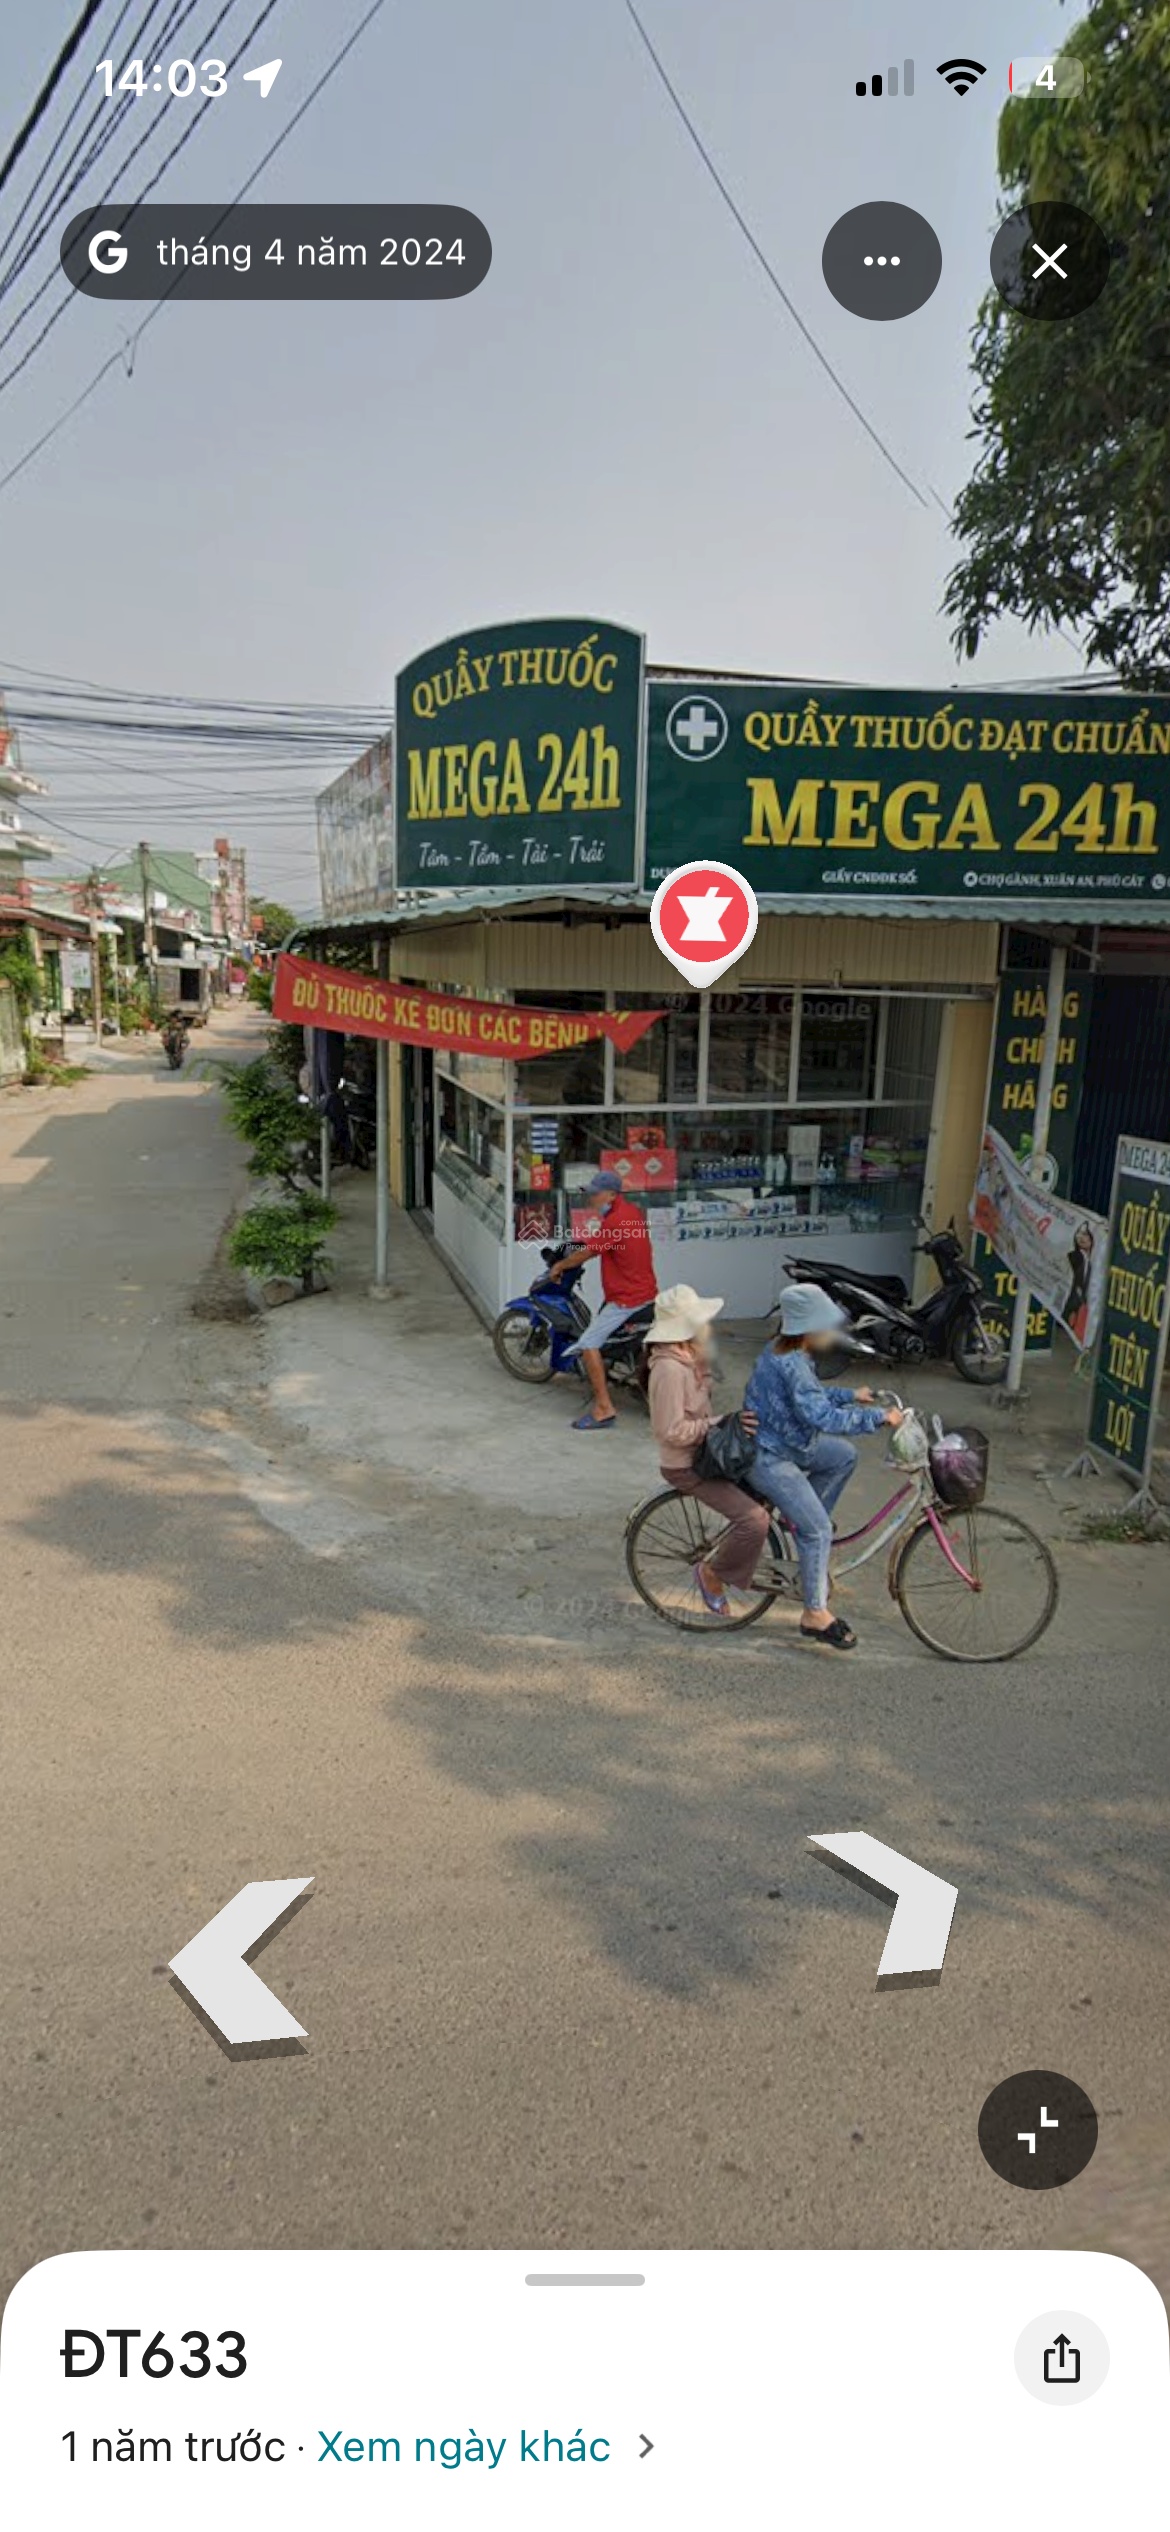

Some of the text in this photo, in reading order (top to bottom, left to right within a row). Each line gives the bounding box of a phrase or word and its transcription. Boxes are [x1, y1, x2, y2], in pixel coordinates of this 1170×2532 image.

[499, 633, 618, 694] THUỐC
[743, 698, 1170, 761] QUẦY THUỐC ĐẠT CHUẨN
[407, 724, 622, 820] MEGA 24h
[743, 776, 1160, 855] MEGA 24h
[1012, 984, 1080, 1019] HÀG
[478, 1008, 522, 1045] CÁC
[1005, 1034, 1077, 1065] CHÍH
[1002, 1079, 1069, 1110] HÀG
